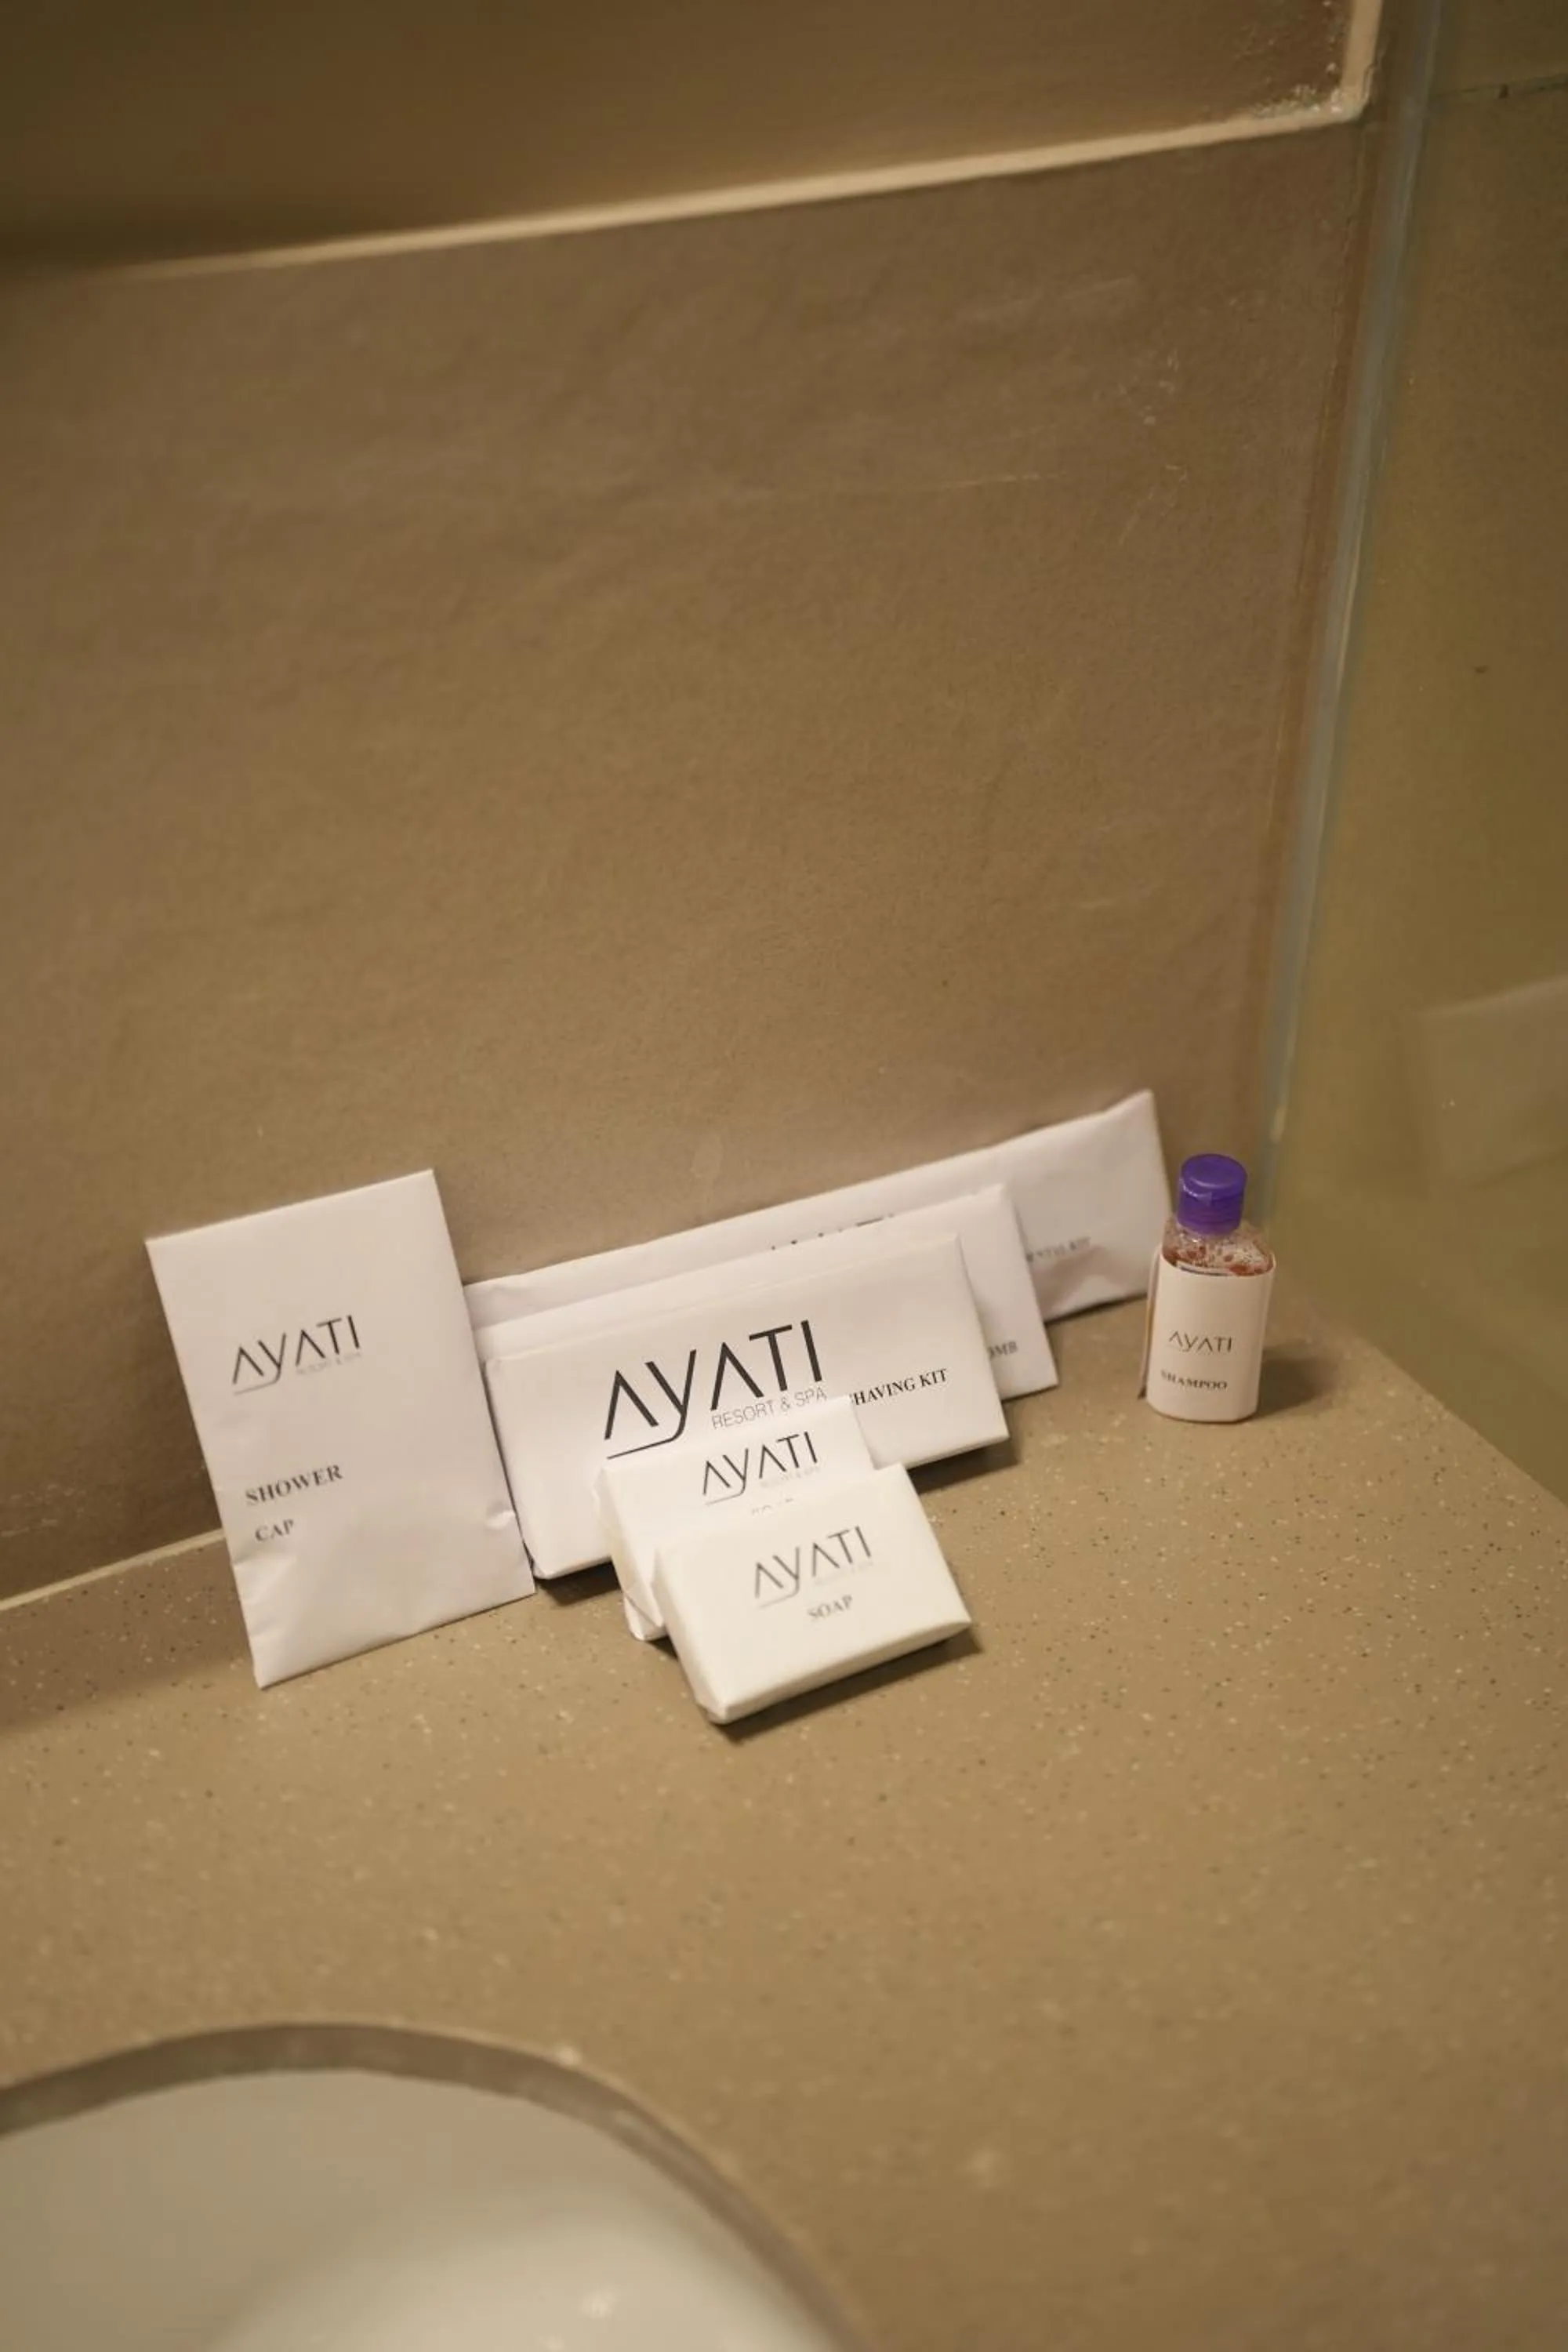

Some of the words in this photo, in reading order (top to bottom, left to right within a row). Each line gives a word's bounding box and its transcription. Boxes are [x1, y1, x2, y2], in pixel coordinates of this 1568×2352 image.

[232, 1314, 360, 1396] AYATI
[1167, 1330, 1232, 1353] AYATI
[604, 1319, 822, 1460] AYATI
[850, 1377, 916, 1406] HAVING
[919, 1368, 947, 1388] KIT
[1161, 1370, 1228, 1390] SHAMPOO
[711, 1399, 775, 1429] RESORT
[780, 1396, 791, 1414] &
[793, 1386, 828, 1408] SPA
[245, 1465, 343, 1505] SHOWER
[702, 1431, 818, 1506] AYATI
[255, 1519, 294, 1542] CAP
[754, 1525, 872, 1609] AYATI
[808, 1595, 854, 1623] SOAP
